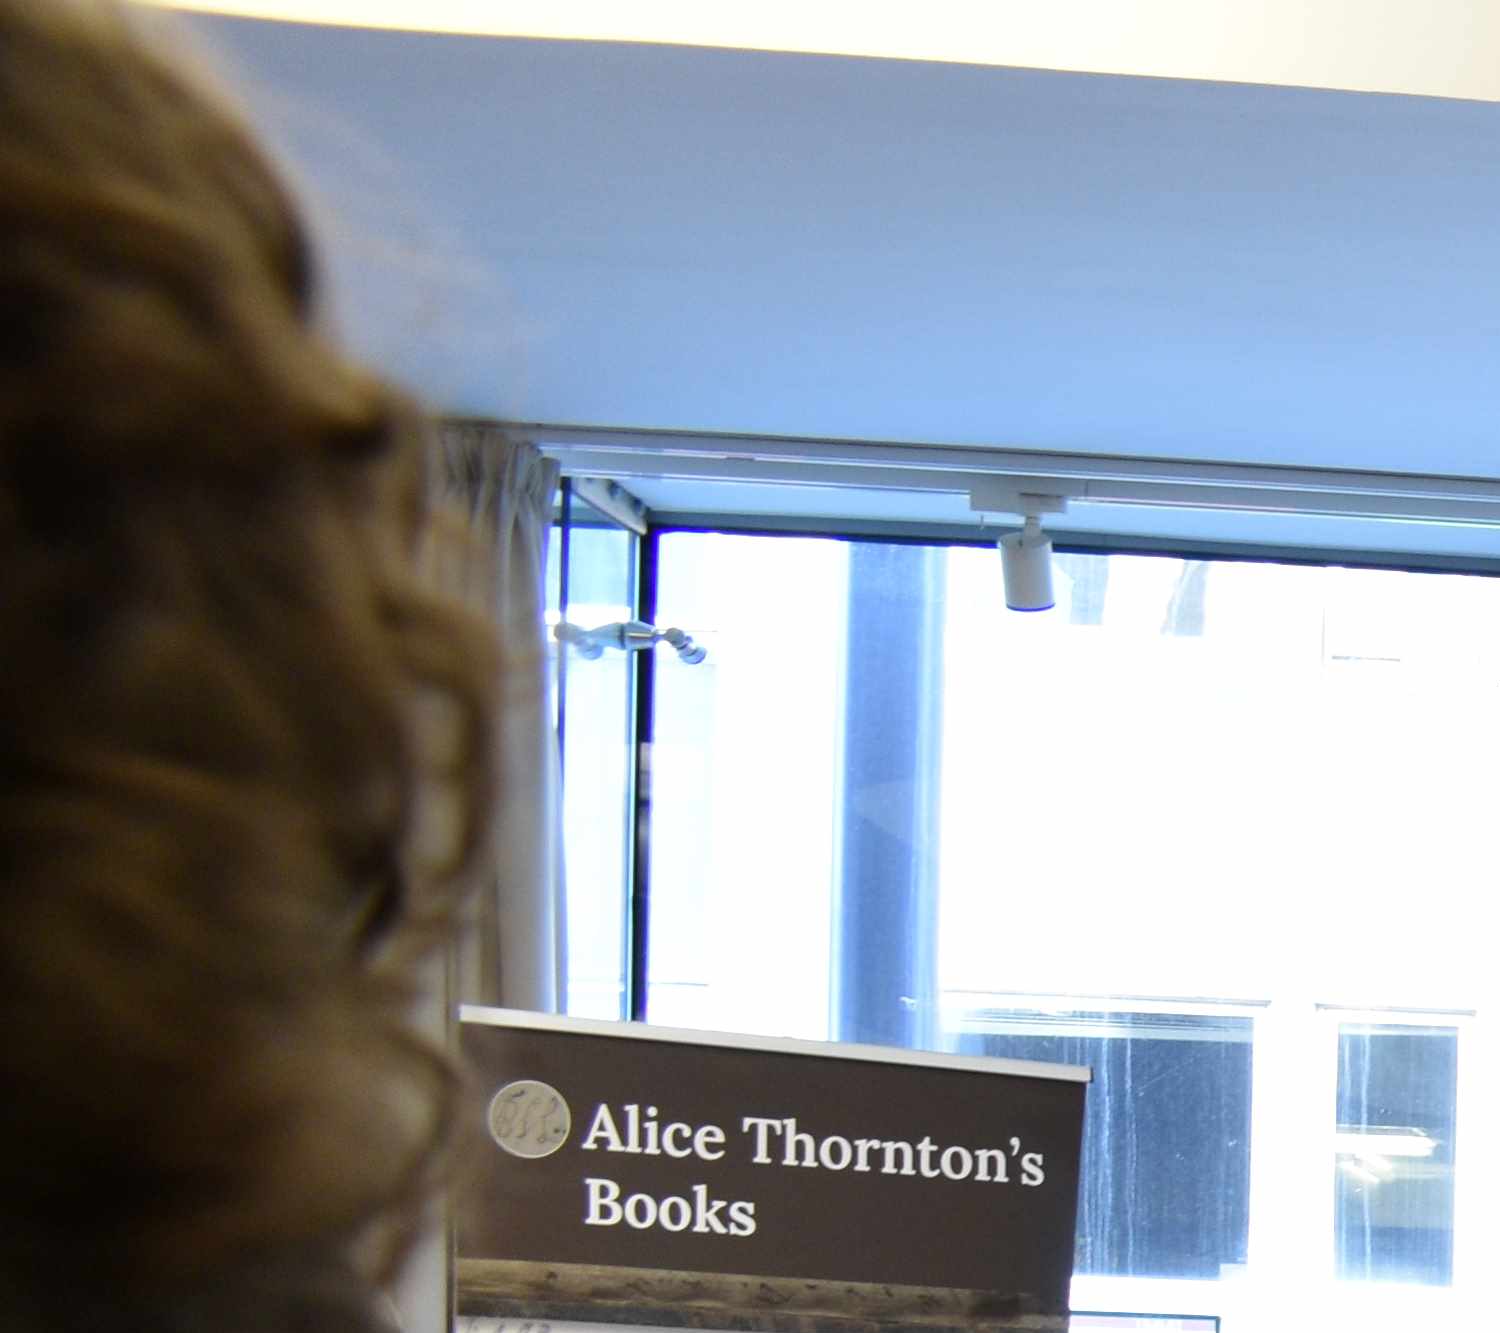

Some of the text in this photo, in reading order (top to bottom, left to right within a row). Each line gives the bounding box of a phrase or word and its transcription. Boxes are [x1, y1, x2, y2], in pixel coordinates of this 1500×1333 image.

[582, 1105, 1043, 1183] Alice Thornton's
[583, 1179, 757, 1234] Books
